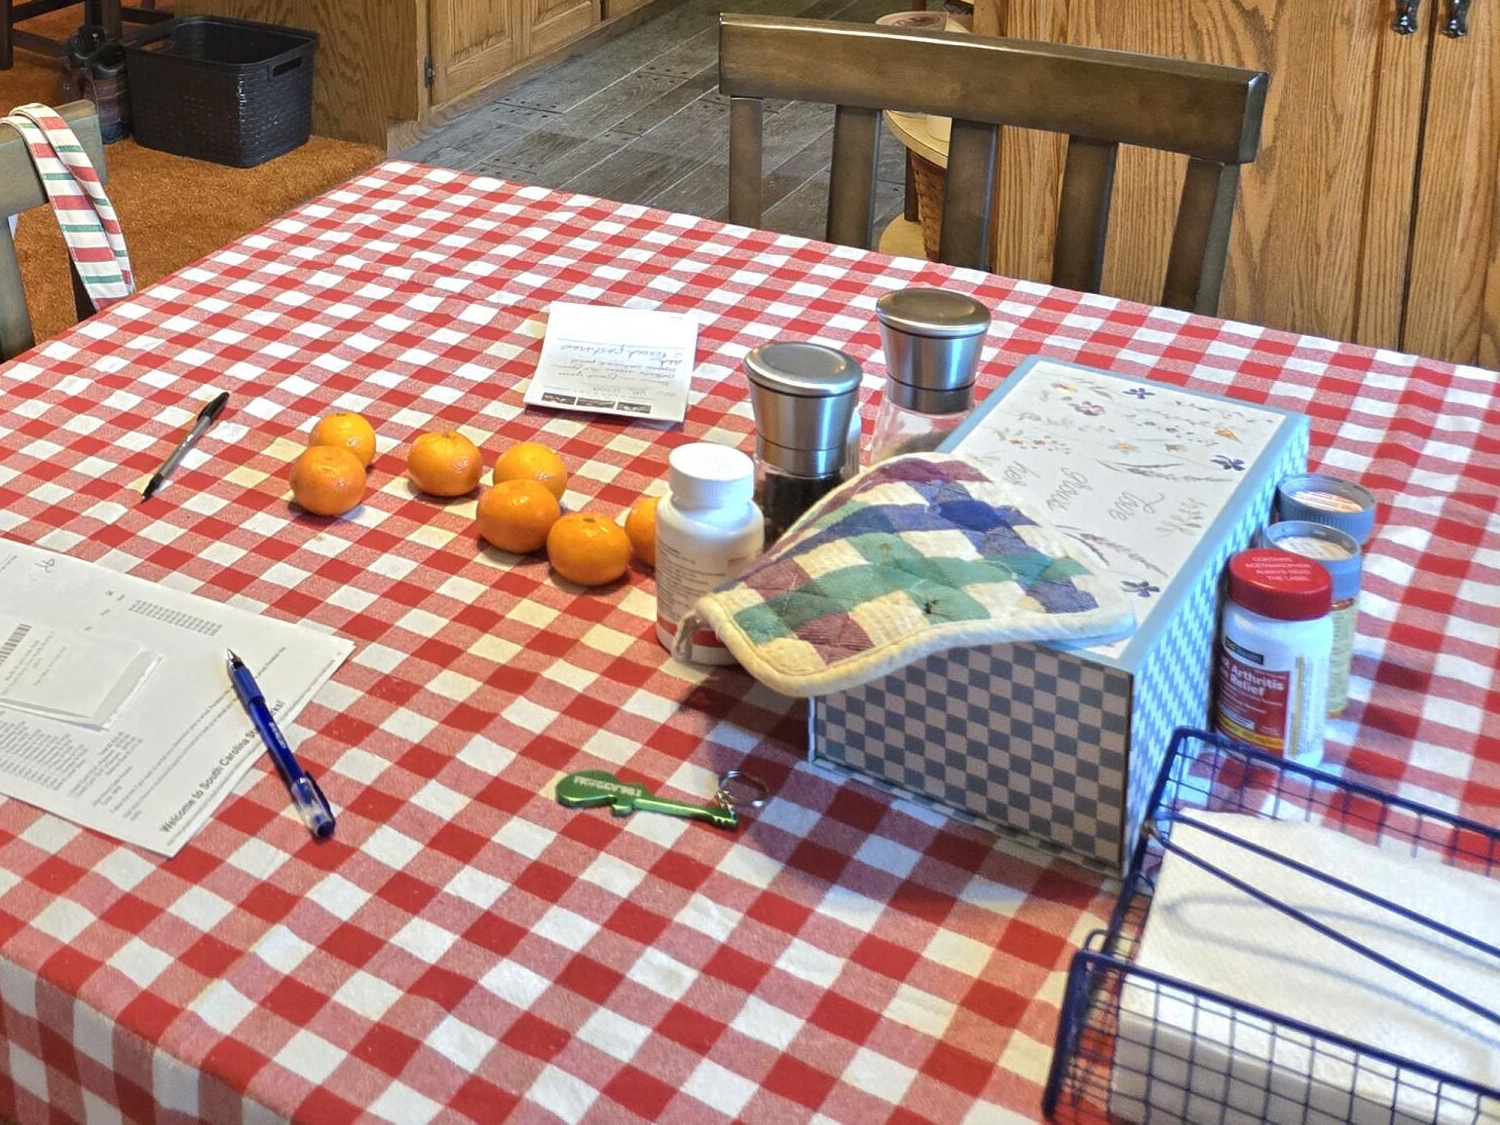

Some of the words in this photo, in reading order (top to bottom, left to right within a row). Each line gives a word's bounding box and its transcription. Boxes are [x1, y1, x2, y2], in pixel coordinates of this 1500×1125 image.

[1108, 492, 1165, 521] Love
[1230, 664, 1284, 692] Arthritis
[1230, 674, 1266, 697] Relief
[160, 798, 197, 833] Welcome
[191, 789, 204, 800] to
[200, 765, 223, 790] South
[219, 738, 250, 767] Carolina
